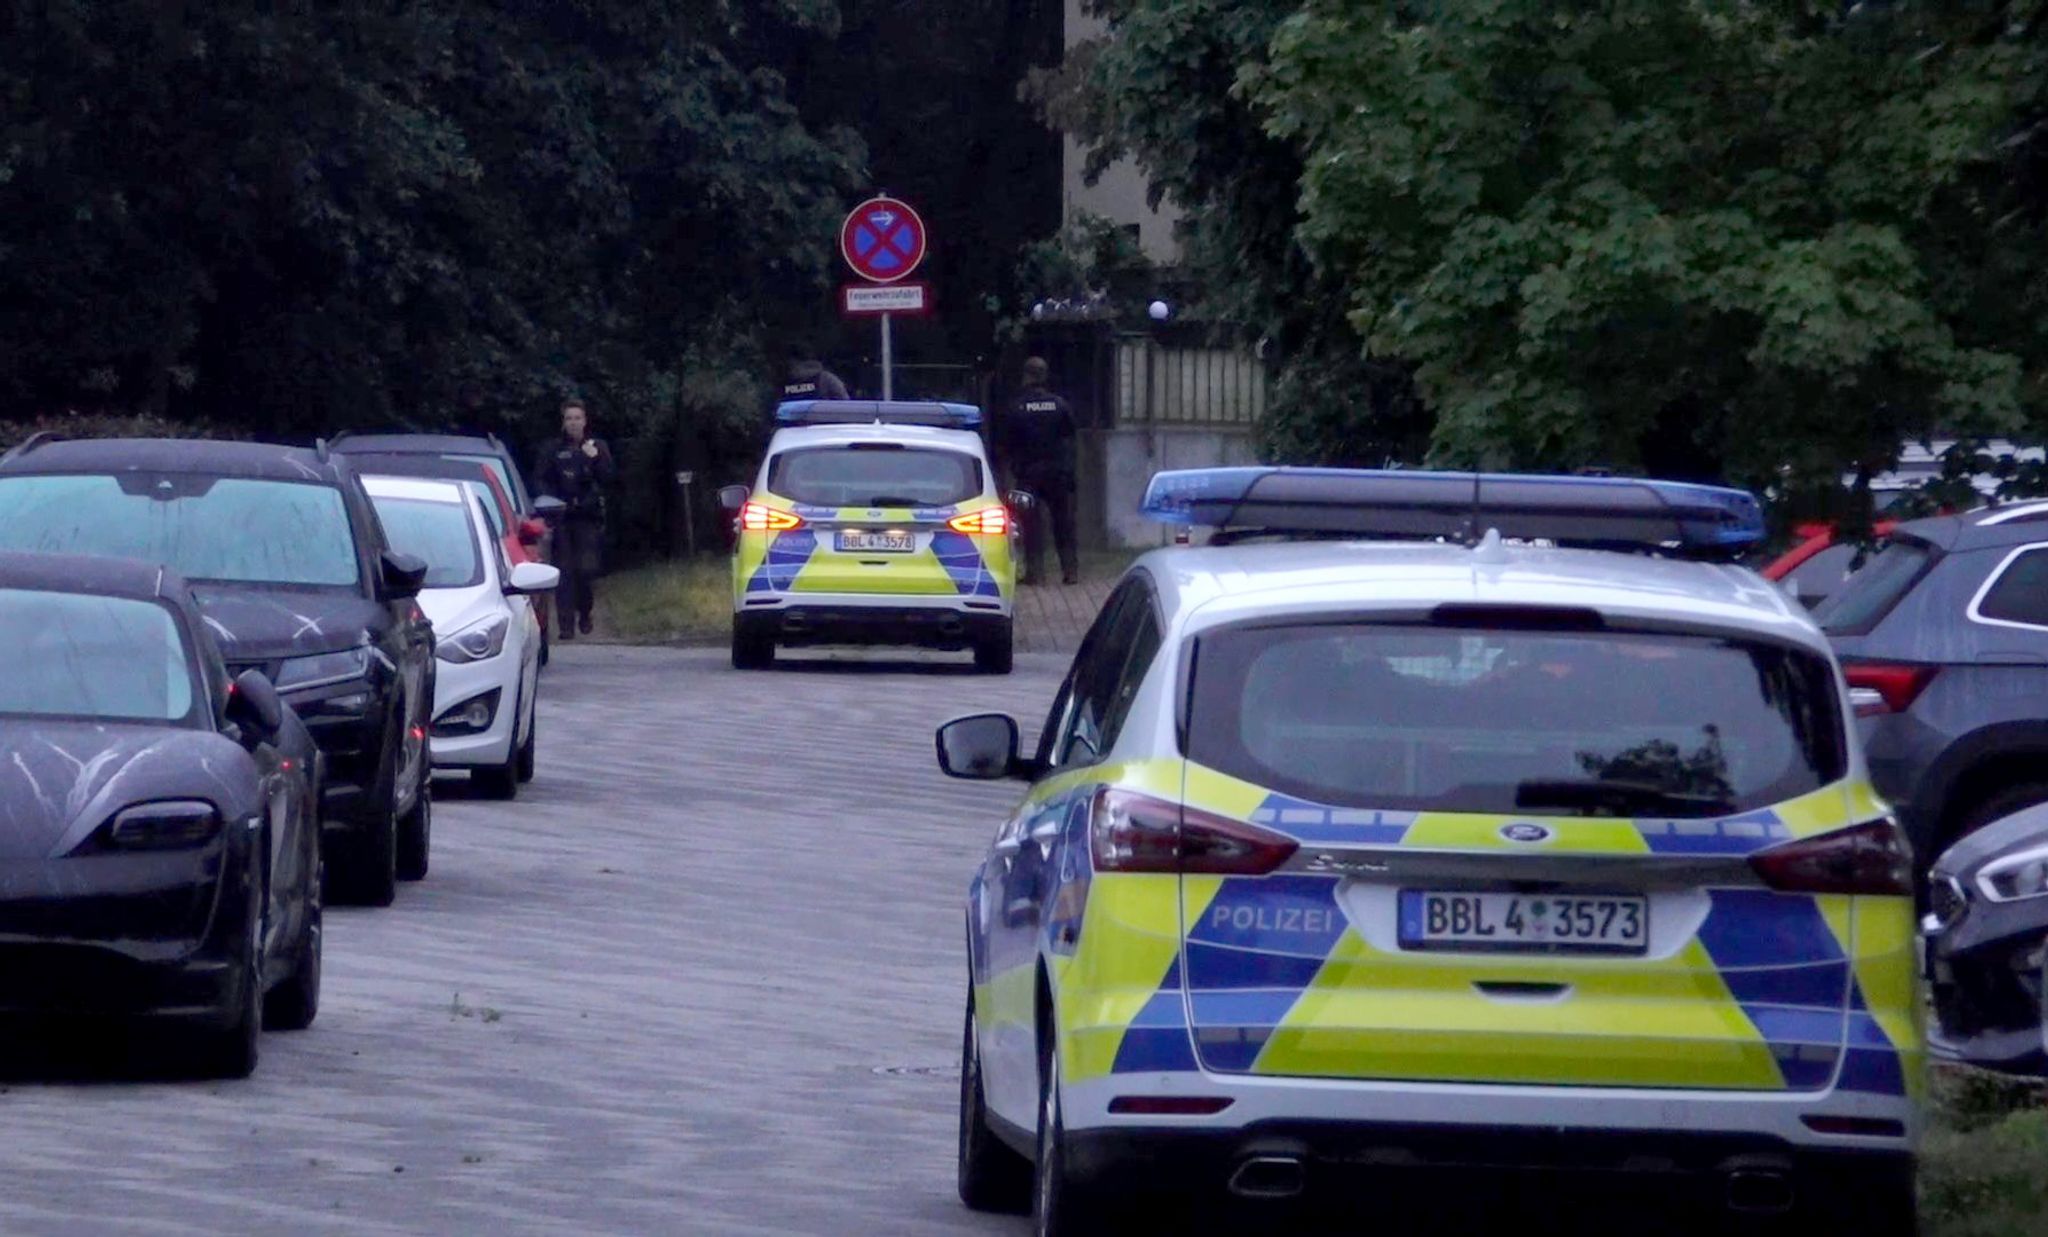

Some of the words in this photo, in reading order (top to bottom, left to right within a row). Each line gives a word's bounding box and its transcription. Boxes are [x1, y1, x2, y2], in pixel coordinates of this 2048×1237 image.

[843, 535, 865, 548] BBL
[1212, 905, 1332, 932] POLIZEI
[1427, 898, 1495, 935] BBL
[1505, 900, 1524, 936] 4
[1553, 900, 1640, 939] 3573
